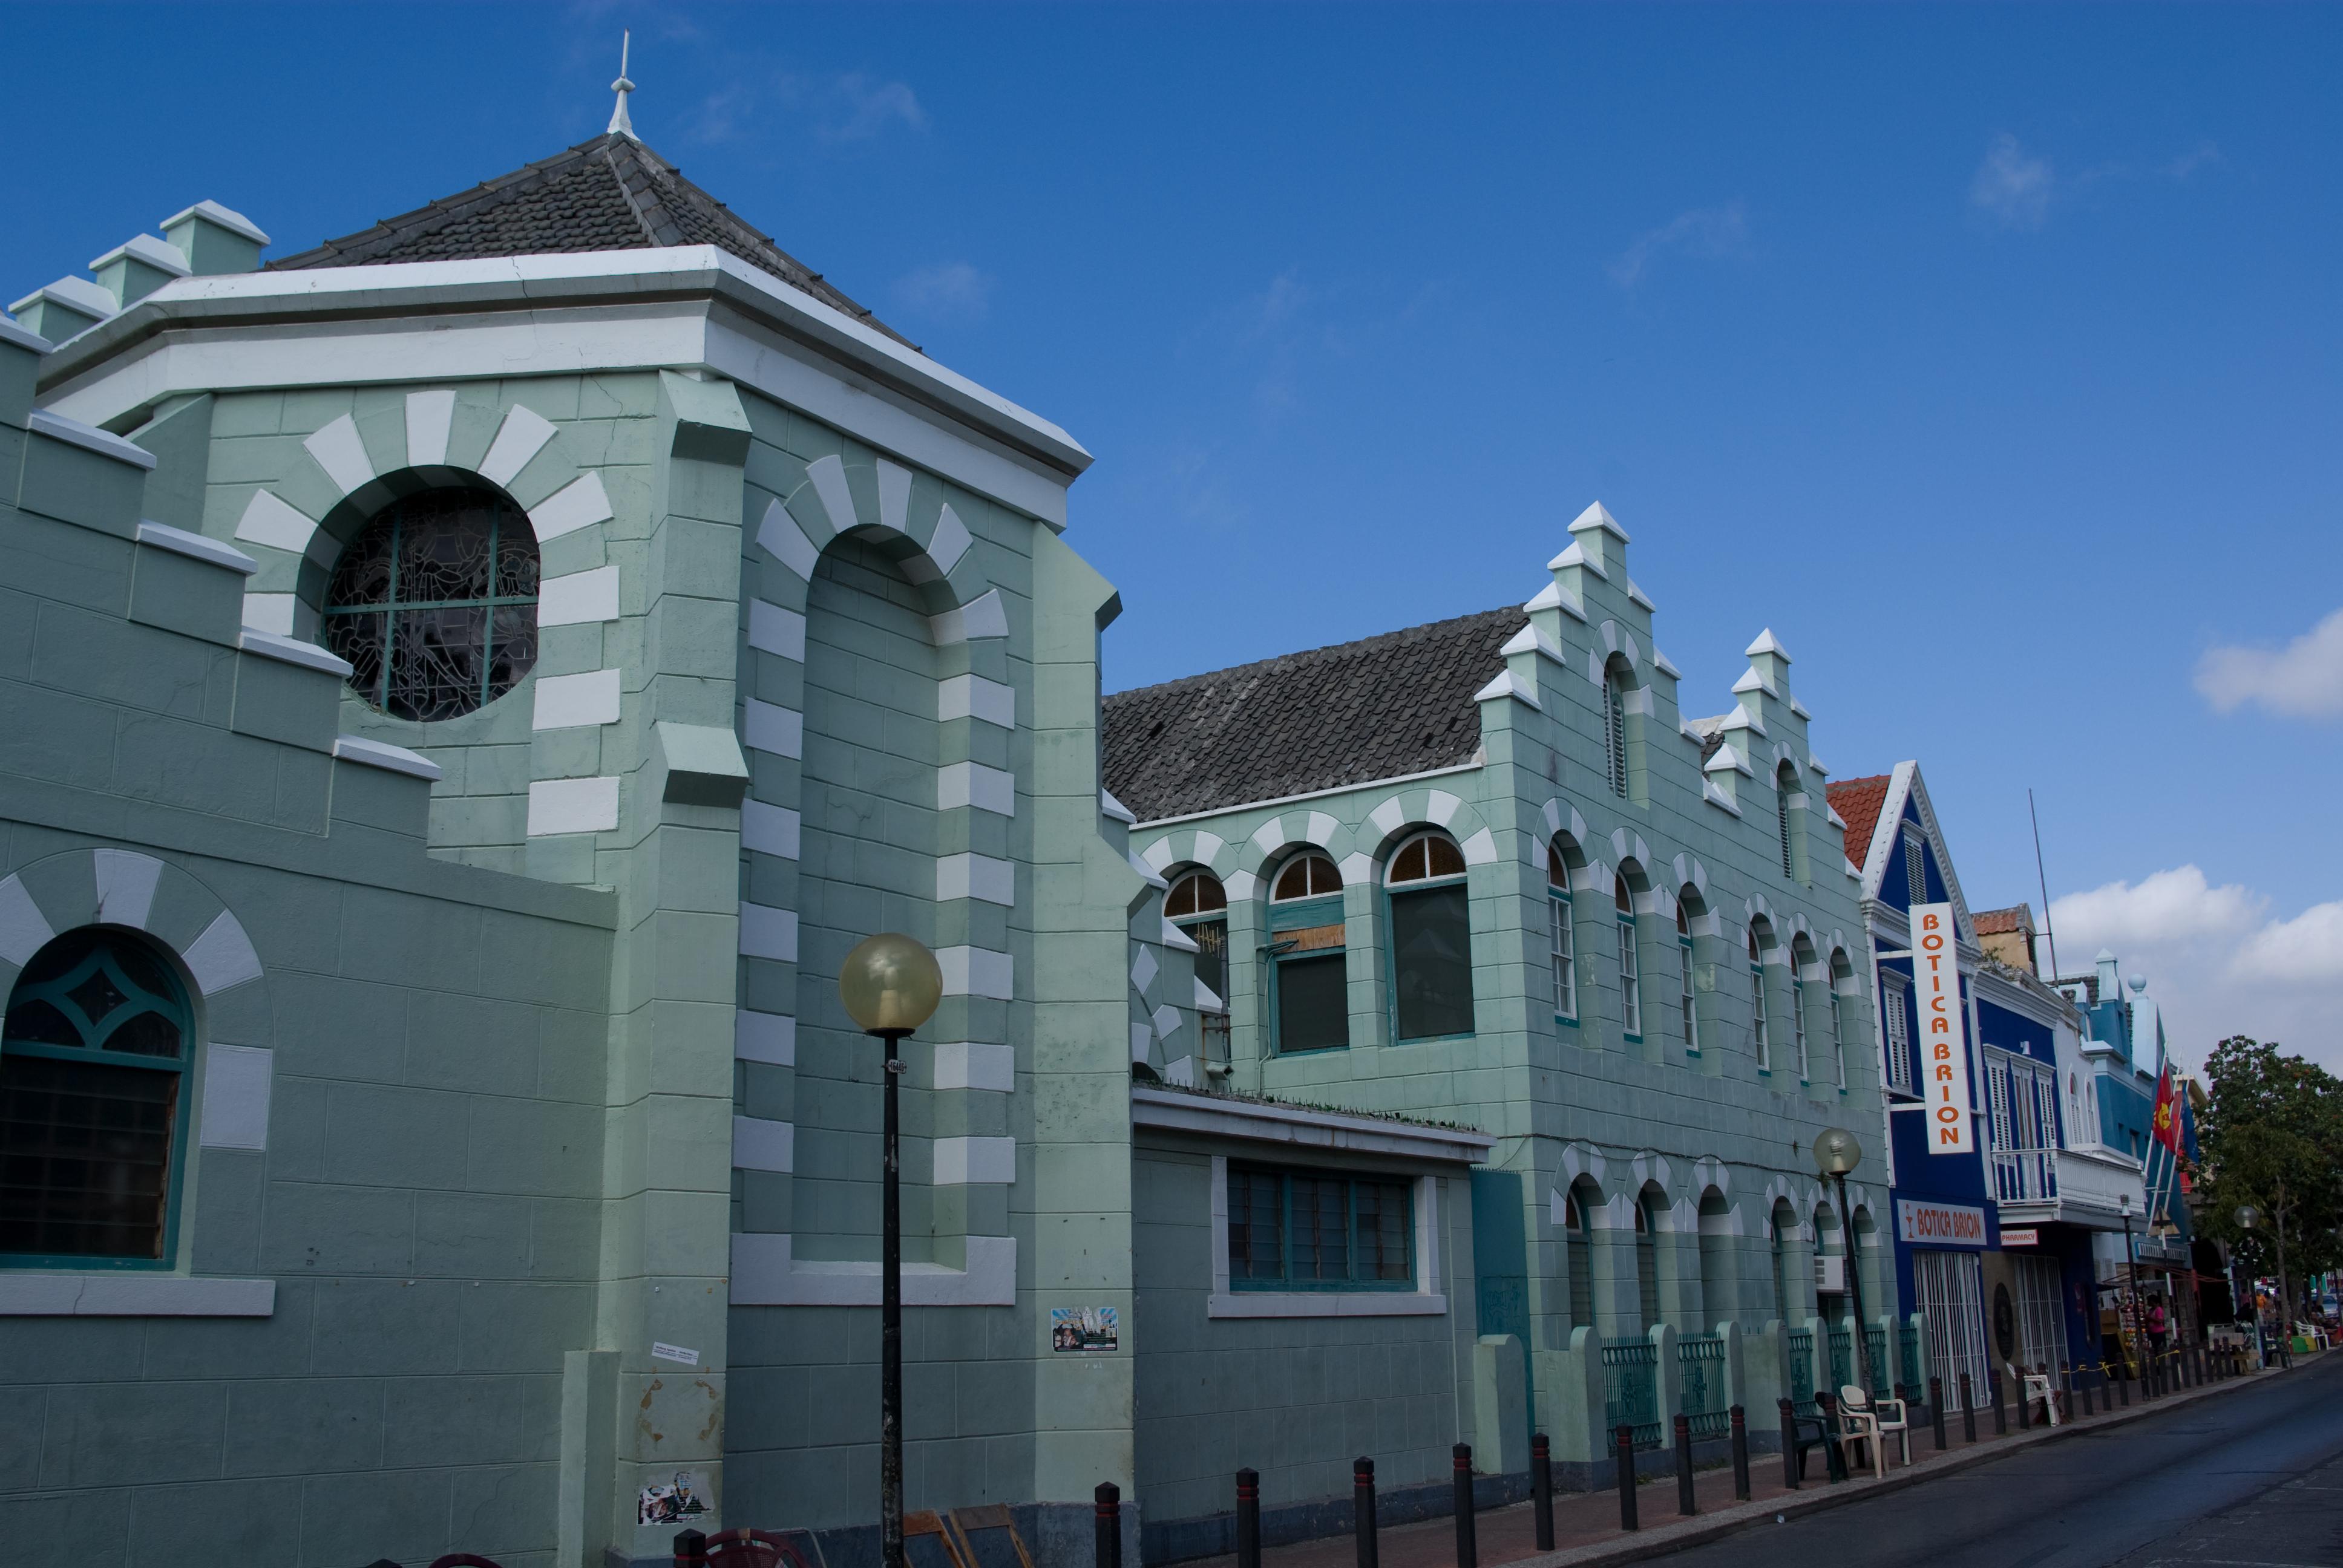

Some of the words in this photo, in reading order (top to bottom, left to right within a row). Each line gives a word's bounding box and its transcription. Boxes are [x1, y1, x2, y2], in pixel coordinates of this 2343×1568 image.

[1922, 914, 1949, 1034] BOTICA
[1933, 1044, 1959, 1145] BRION
[1917, 1209, 1951, 1237] BOTICA
[1953, 1212, 1981, 1239] BRION
